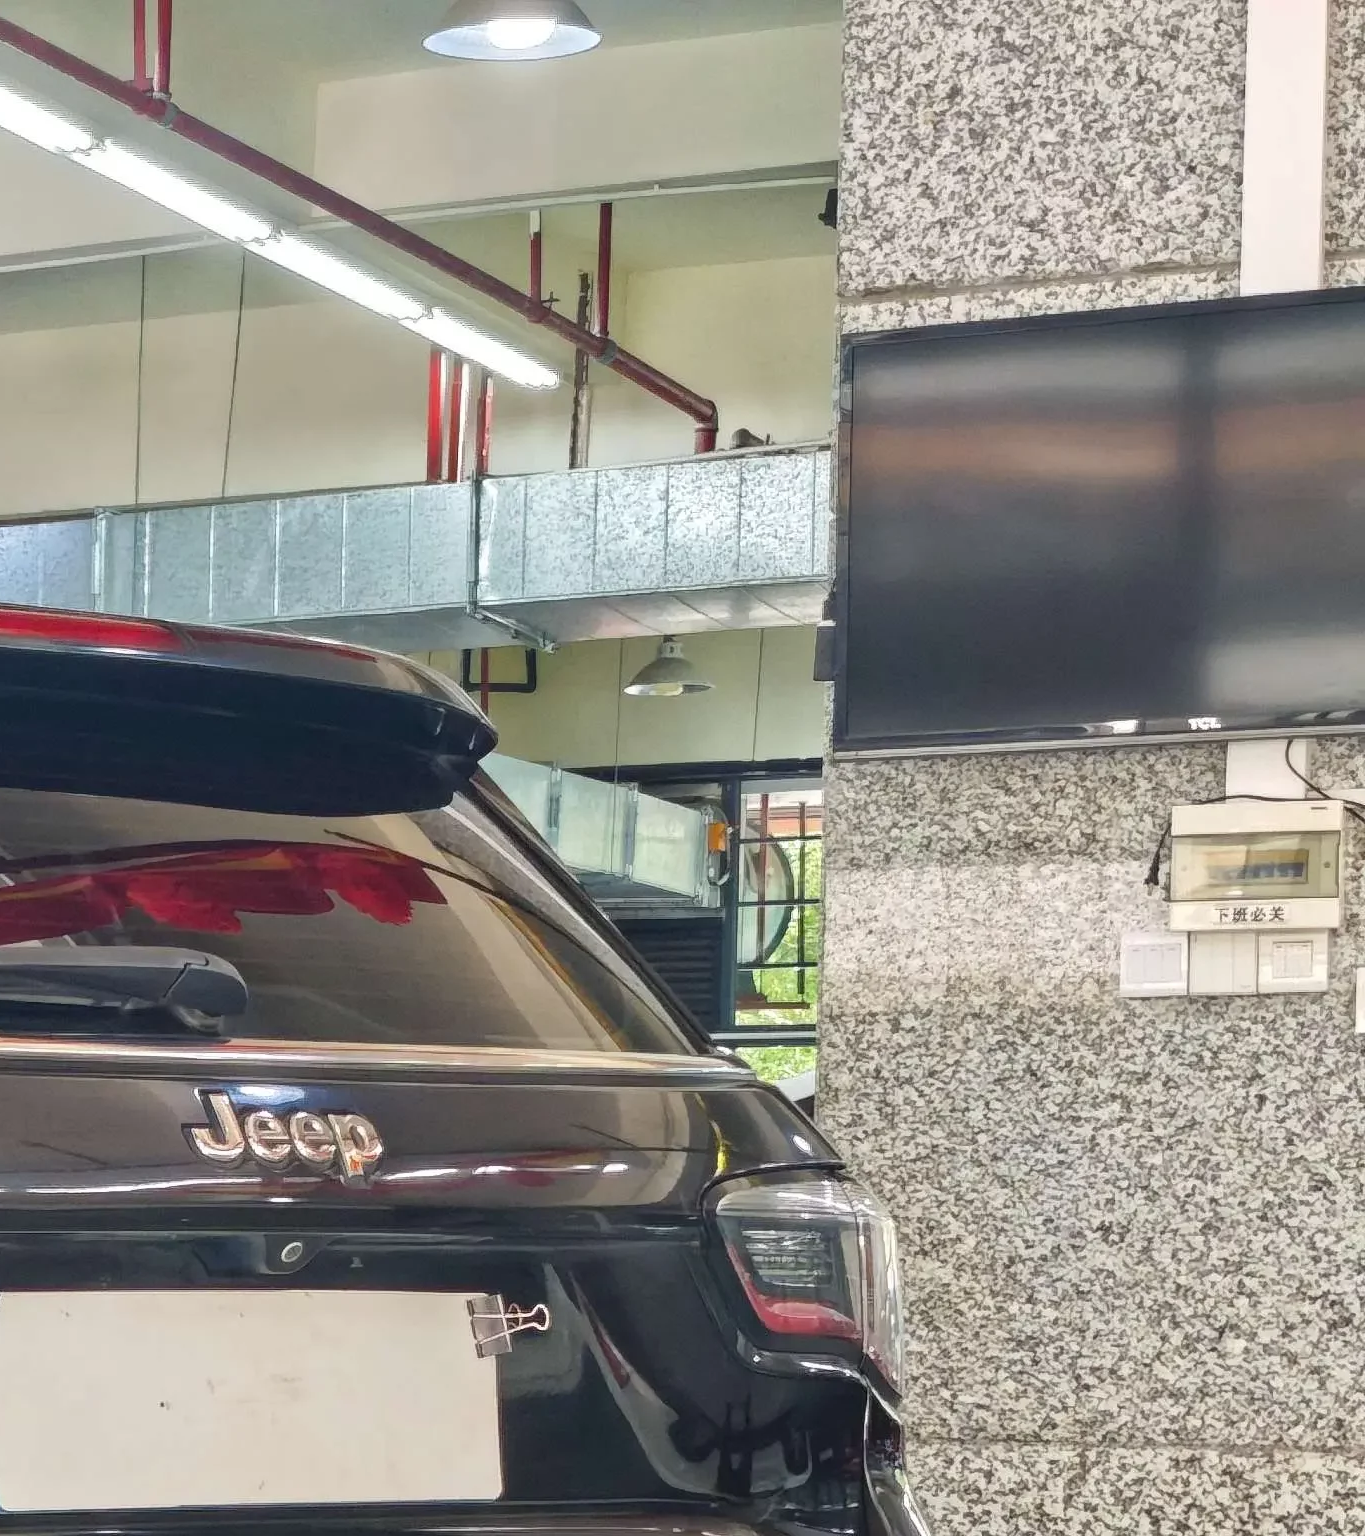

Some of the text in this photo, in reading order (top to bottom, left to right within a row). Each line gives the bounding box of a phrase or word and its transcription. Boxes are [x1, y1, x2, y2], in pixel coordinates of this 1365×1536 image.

[1187, 717, 1222, 731] TCL
[1214, 906, 1285, 924] 下班必关
[181, 1088, 385, 1188] Jeep
